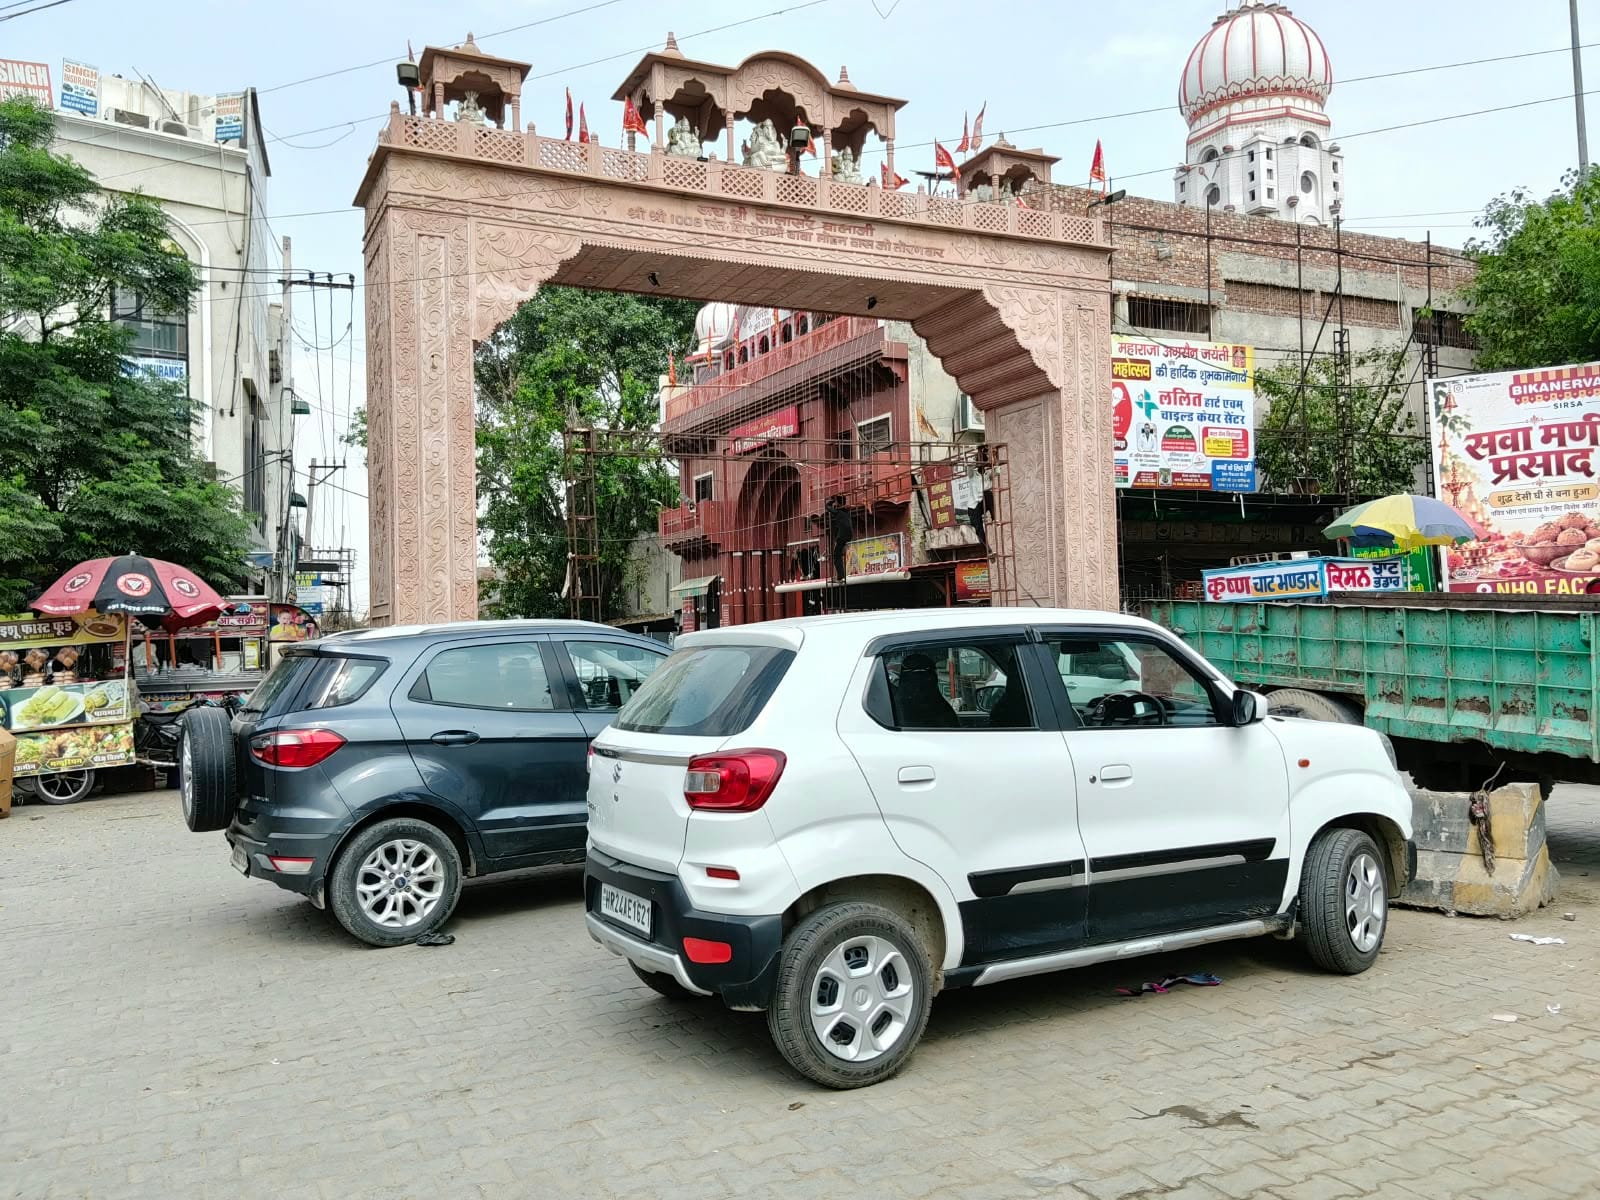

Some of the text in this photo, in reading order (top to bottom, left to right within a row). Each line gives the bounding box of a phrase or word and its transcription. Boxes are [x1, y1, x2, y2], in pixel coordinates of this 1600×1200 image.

[63, 73, 96, 89] INSURANCE
[64, 64, 97, 80] SINGH
[628, 207, 646, 221] श्री
[649, 209, 667, 223] श्री
[670, 214, 702, 227] 1008
[730, 206, 746, 221] श्री
[1118, 342, 1159, 357] महाराजा
[1200, 345, 1229, 361] जयंती
[1112, 360, 1151, 379] महोत्सव
[1155, 363, 1168, 378] की
[1170, 364, 1197, 380] हार्दिक
[1158, 387, 1202, 407] ललित
[1204, 396, 1220, 408] हार्ट
[1553, 400, 1583, 409] SIRSA
[1161, 410, 1194, 422] चाइल्ड
[1463, 426, 1533, 460] सवा
[1488, 448, 1595, 486] प्रसाद
[1497, 487, 1591, 505] शुद्ध देसी घी से बना हुआ
[1252, 575, 1276, 593] चाट
[1276, 570, 1320, 591] भण्डार
[21, 623, 50, 634] फास्ट
[52, 621, 72, 635] फूड
